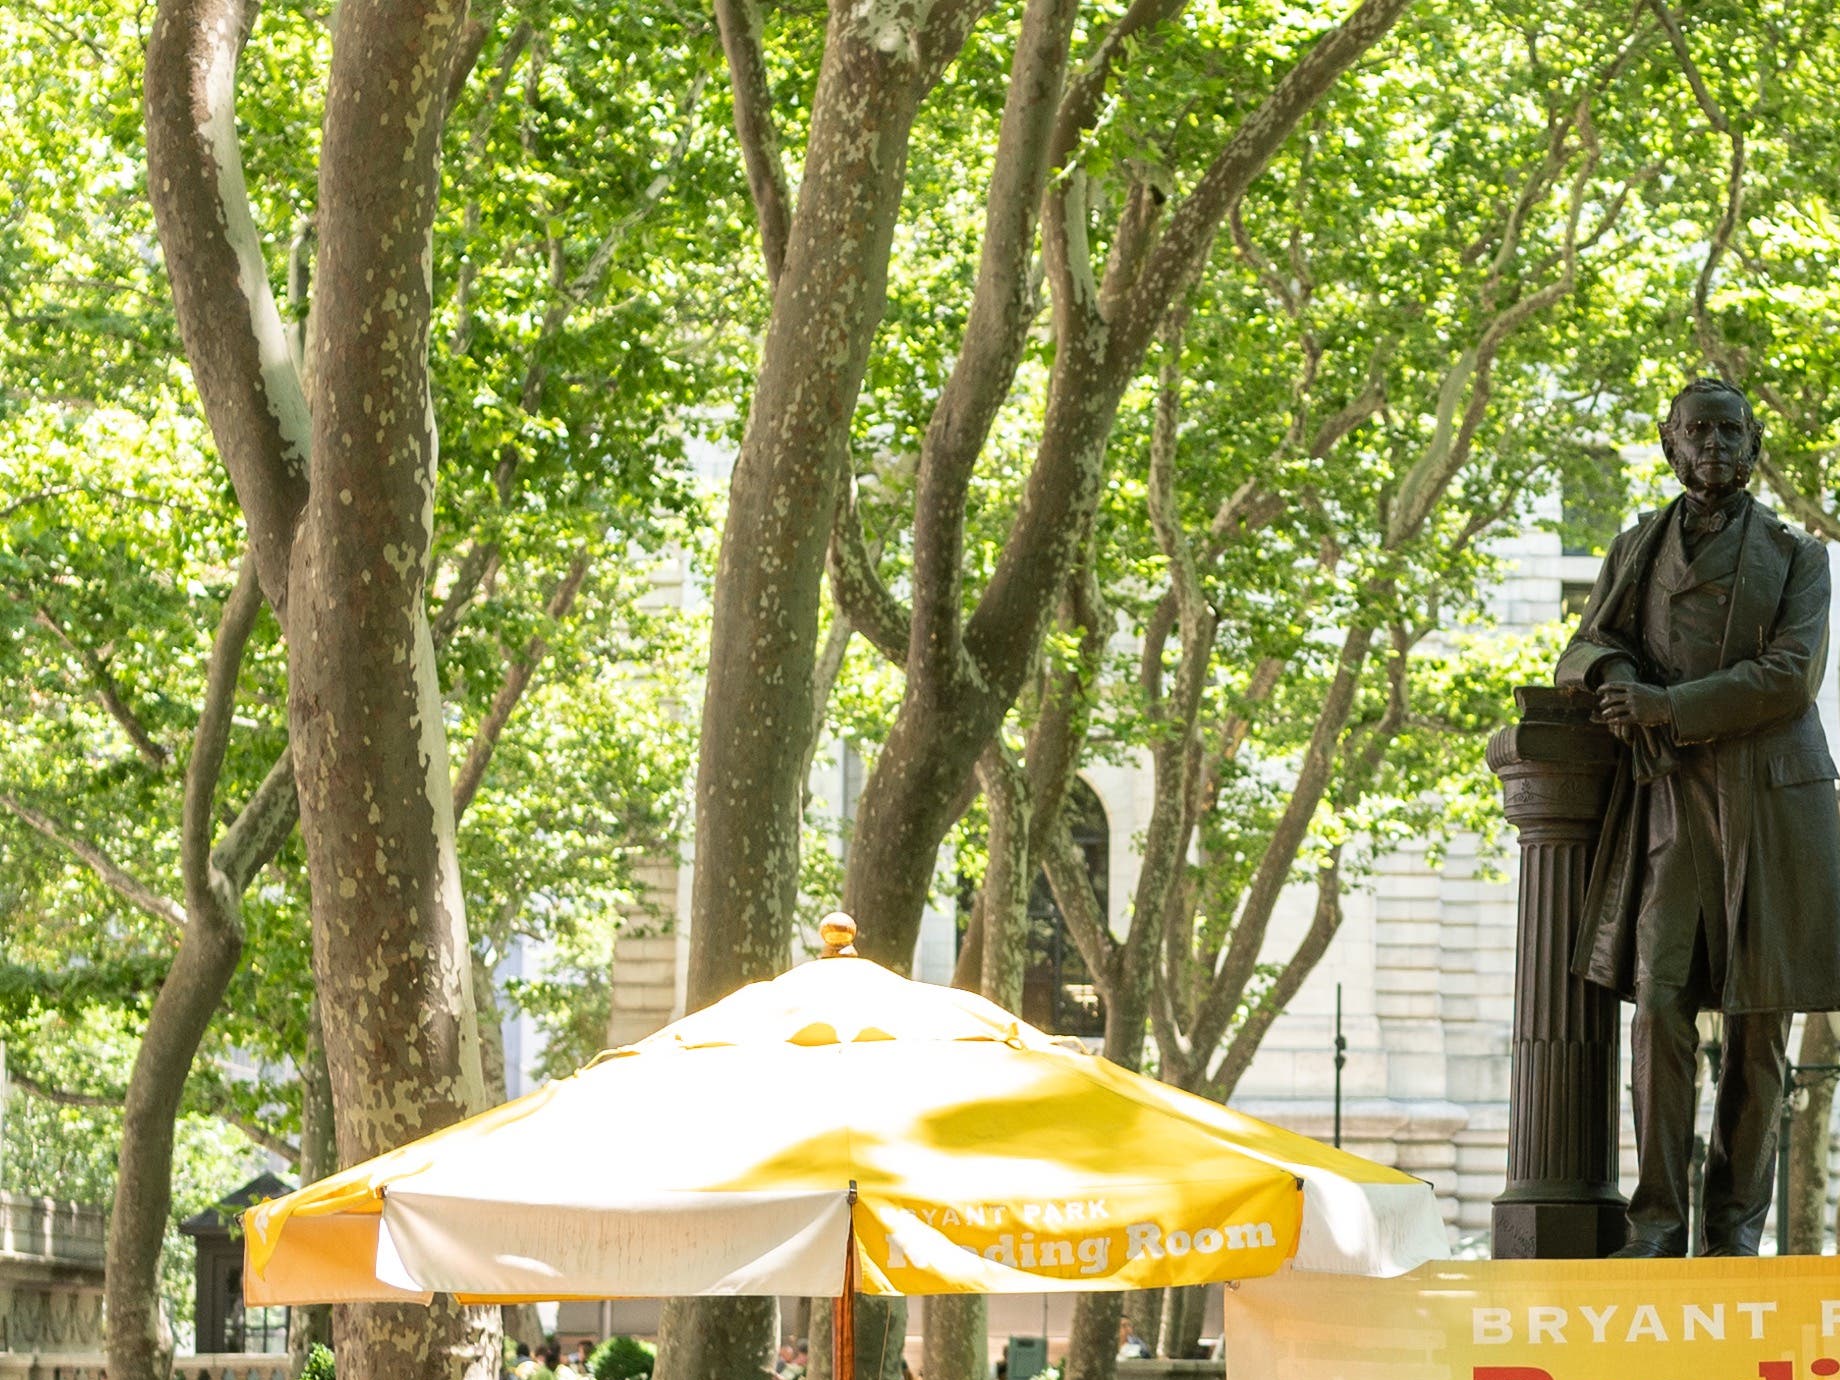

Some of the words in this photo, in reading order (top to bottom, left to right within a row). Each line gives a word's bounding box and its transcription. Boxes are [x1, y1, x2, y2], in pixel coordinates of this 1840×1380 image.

[880, 1204, 1008, 1228] YANT
[1023, 1199, 1110, 1226] PARK
[885, 1233, 1111, 1275] Rding
[1126, 1219, 1276, 1260] Room
[1472, 1302, 1778, 1345] BRYANT
